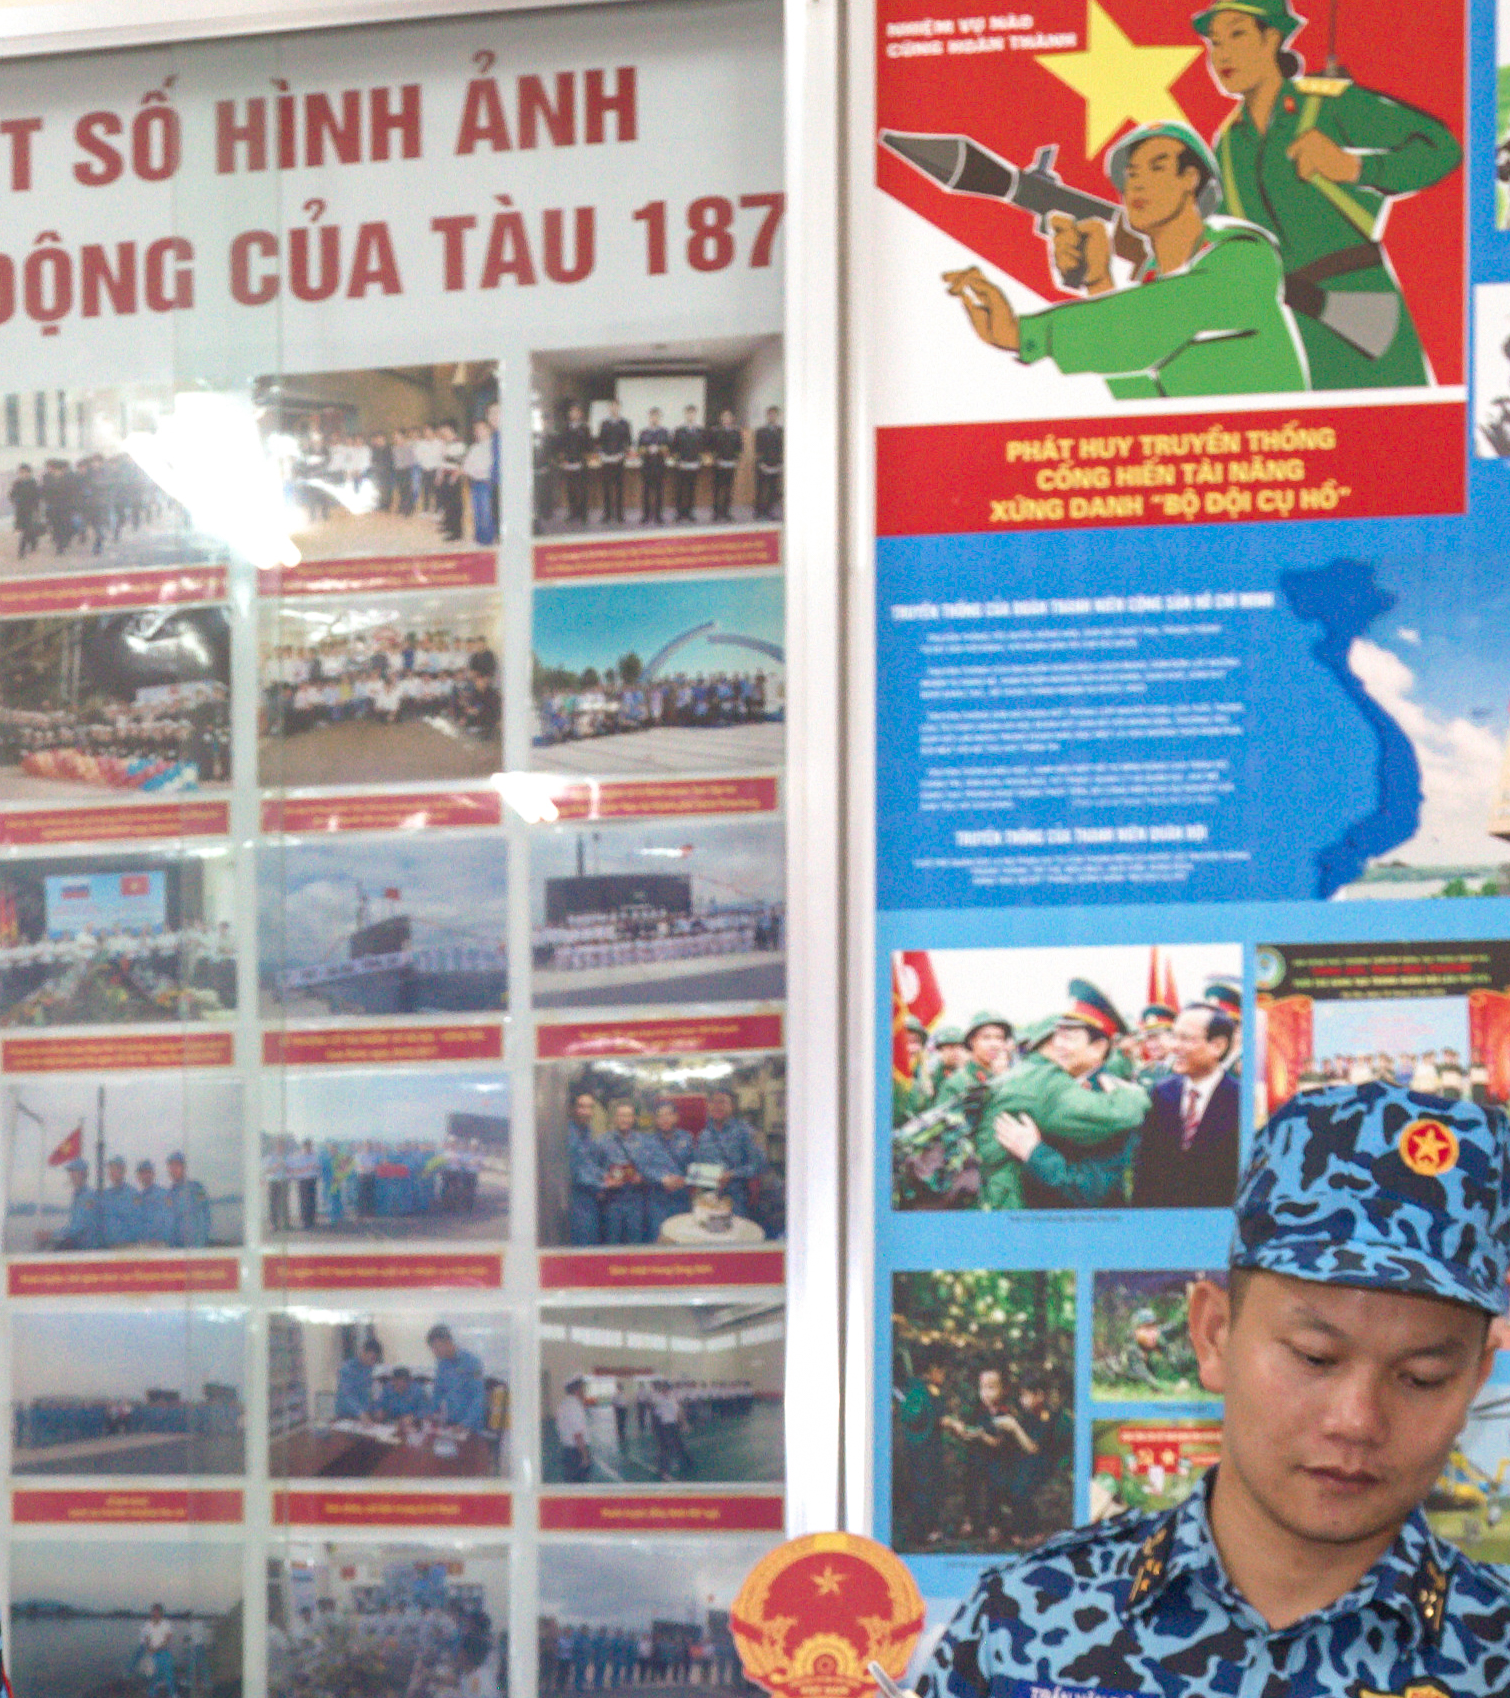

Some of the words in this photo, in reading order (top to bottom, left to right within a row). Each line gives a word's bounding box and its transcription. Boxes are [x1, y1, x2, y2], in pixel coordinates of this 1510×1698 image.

[73, 77, 180, 188] SỐ
[215, 77, 422, 176] HÌNH
[456, 51, 639, 156] ẢNH
[230, 199, 403, 307] CỦA
[432, 195, 596, 293] TÀU
[632, 192, 787, 276] 187
[1006, 433, 1074, 462] PHÁT
[1078, 436, 1133, 459] HUY
[1139, 423, 1241, 456] TRUYỀN
[1246, 419, 1336, 451] THỐNG
[1036, 458, 1111, 491] CỐNG
[1114, 456, 1176, 487] HIẾN
[1181, 458, 1223, 484] TÀI
[1228, 455, 1305, 482] NĂNG
[1069, 495, 1143, 518] DANH
[1257, 488, 1295, 518] CỤ
